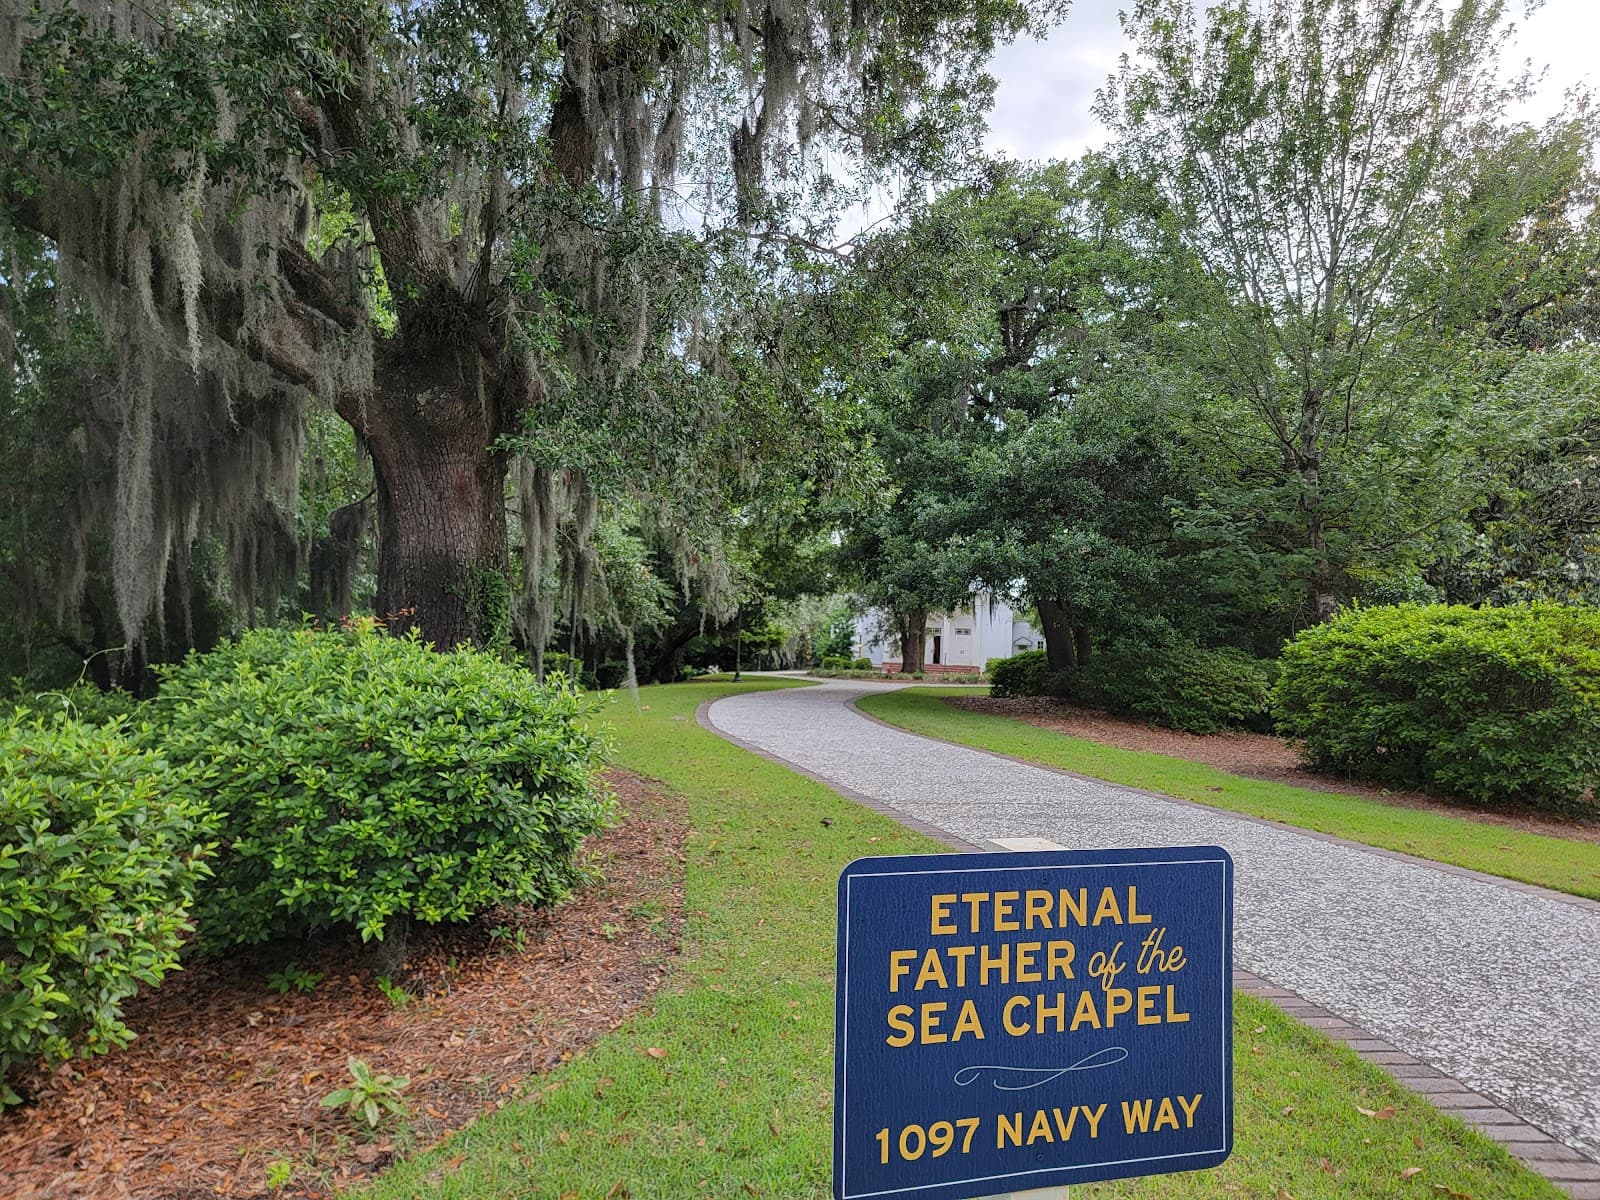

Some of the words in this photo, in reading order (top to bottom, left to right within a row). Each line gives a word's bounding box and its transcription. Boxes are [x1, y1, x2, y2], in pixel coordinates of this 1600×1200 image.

[930, 885, 1152, 936] ETERNAL
[889, 940, 1076, 993] FATHER
[1087, 941, 1126, 990] of
[1136, 927, 1187, 974] the
[886, 999, 985, 1048] SEA
[1002, 984, 1190, 1037] CHAPEL
[875, 1117, 980, 1164] 1097
[997, 1103, 1108, 1149] NAVY
[1121, 1093, 1202, 1135] WAY
